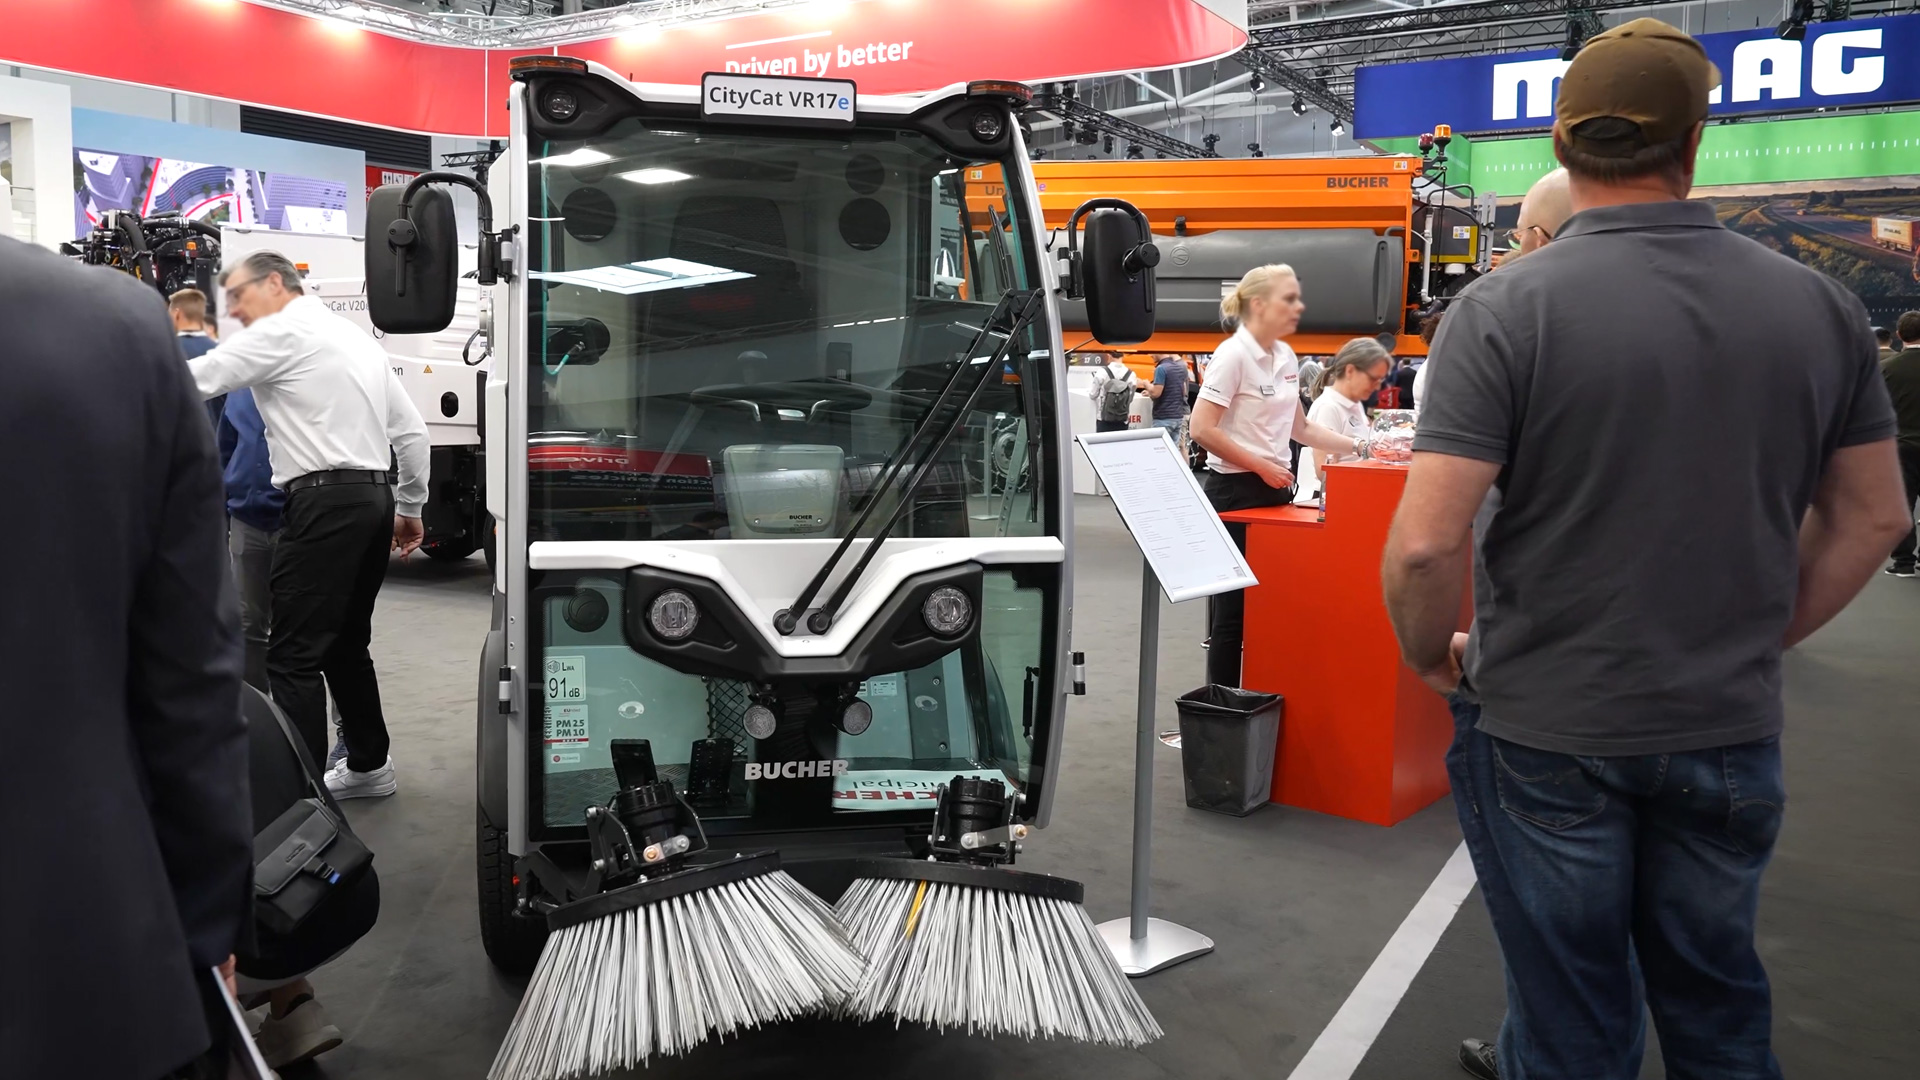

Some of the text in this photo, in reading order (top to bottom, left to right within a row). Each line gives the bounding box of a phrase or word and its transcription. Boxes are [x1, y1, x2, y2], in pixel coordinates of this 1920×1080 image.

[804, 48, 831, 77] by
[837, 41, 914, 68] better
[709, 86, 850, 110] CityCat VR17e
[1326, 176, 1389, 188] BUCHER
[549, 677, 580, 698] 91 dB
[556, 720, 571, 728] PM
[556, 729, 585, 737] PM 10
[744, 759, 849, 781] BUCHER
